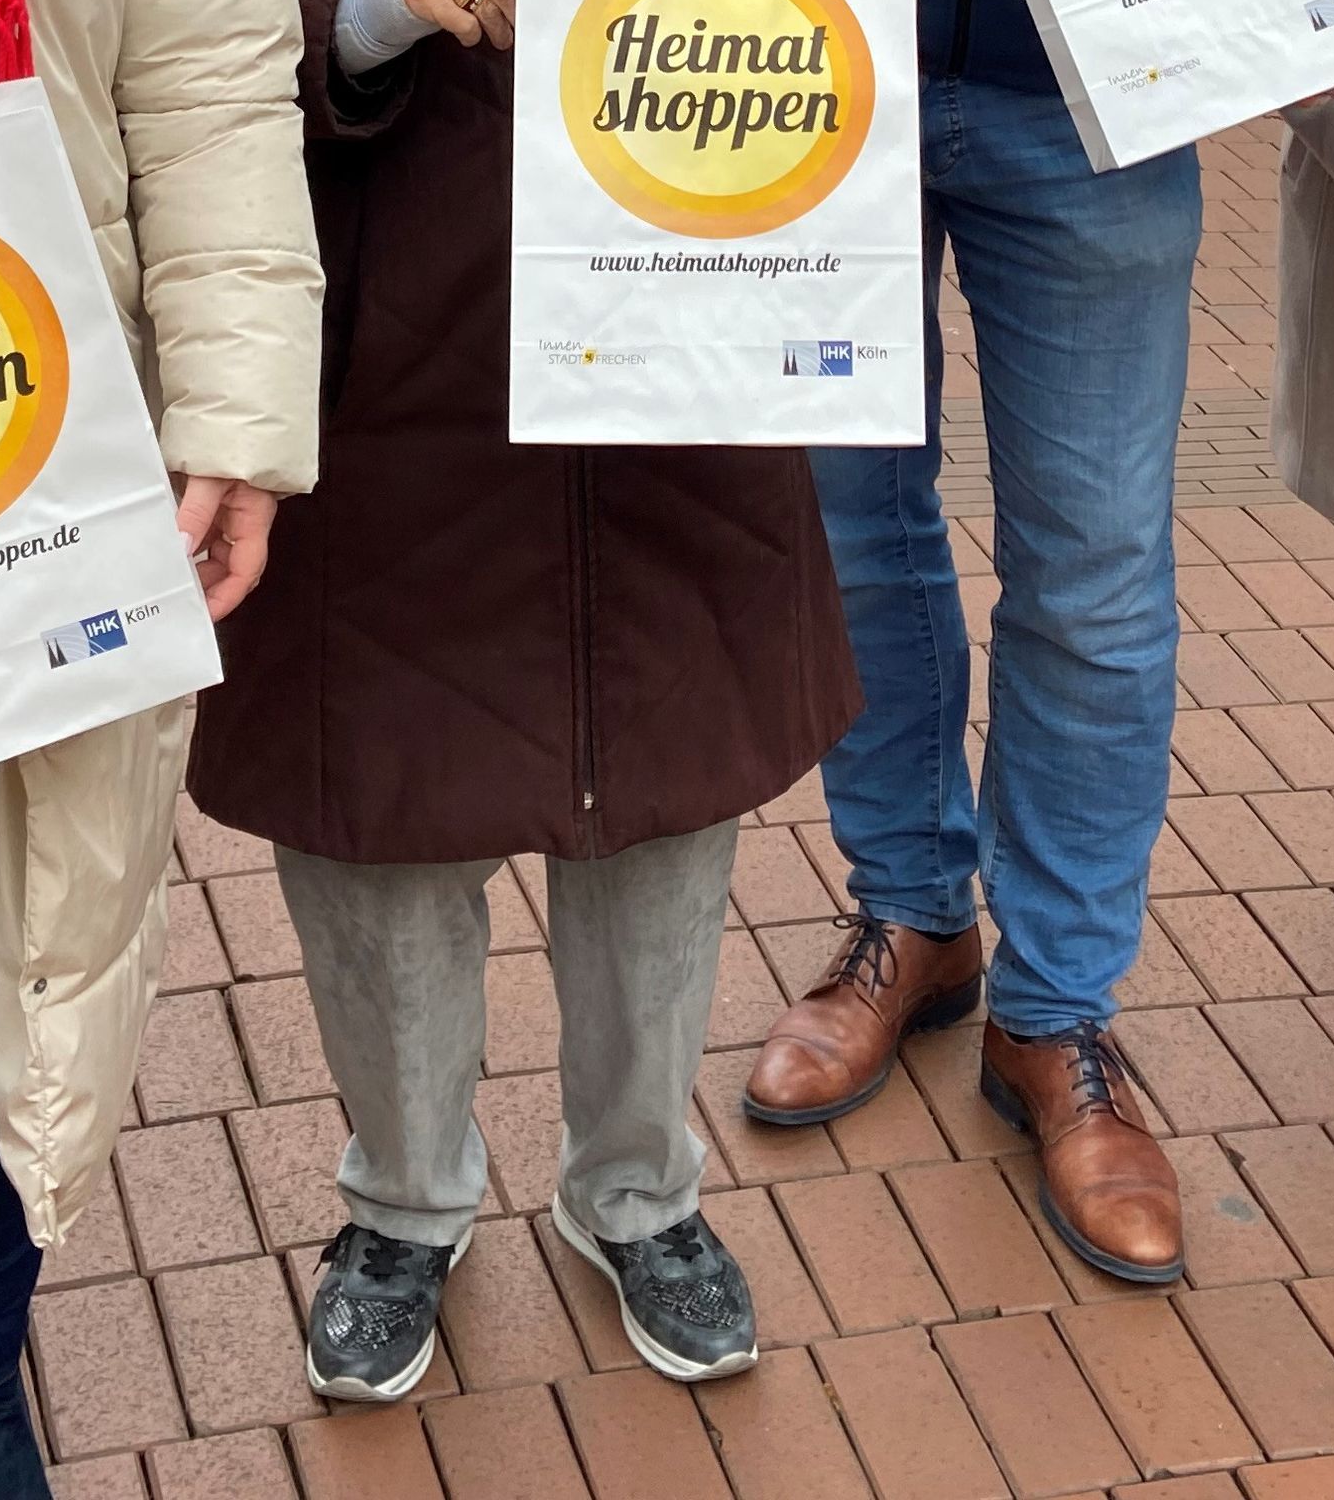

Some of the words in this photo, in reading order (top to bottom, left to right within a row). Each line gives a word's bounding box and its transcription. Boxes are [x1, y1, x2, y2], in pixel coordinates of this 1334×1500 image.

[606, 13, 829, 77] Heimat
[1107, 67, 1146, 86] Innen
[592, 77, 840, 151] shoppen
[589, 252, 841, 280] www.heimatshoppen.de
[538, 339, 584, 351] Innen
[822, 345, 851, 360] IHK
[856, 345, 888, 360] Köln
[548, 353, 584, 365] STADT
[595, 353, 647, 365] FRECHEN
[86, 615, 121, 638] IHK
[124, 604, 161, 625] Köln
